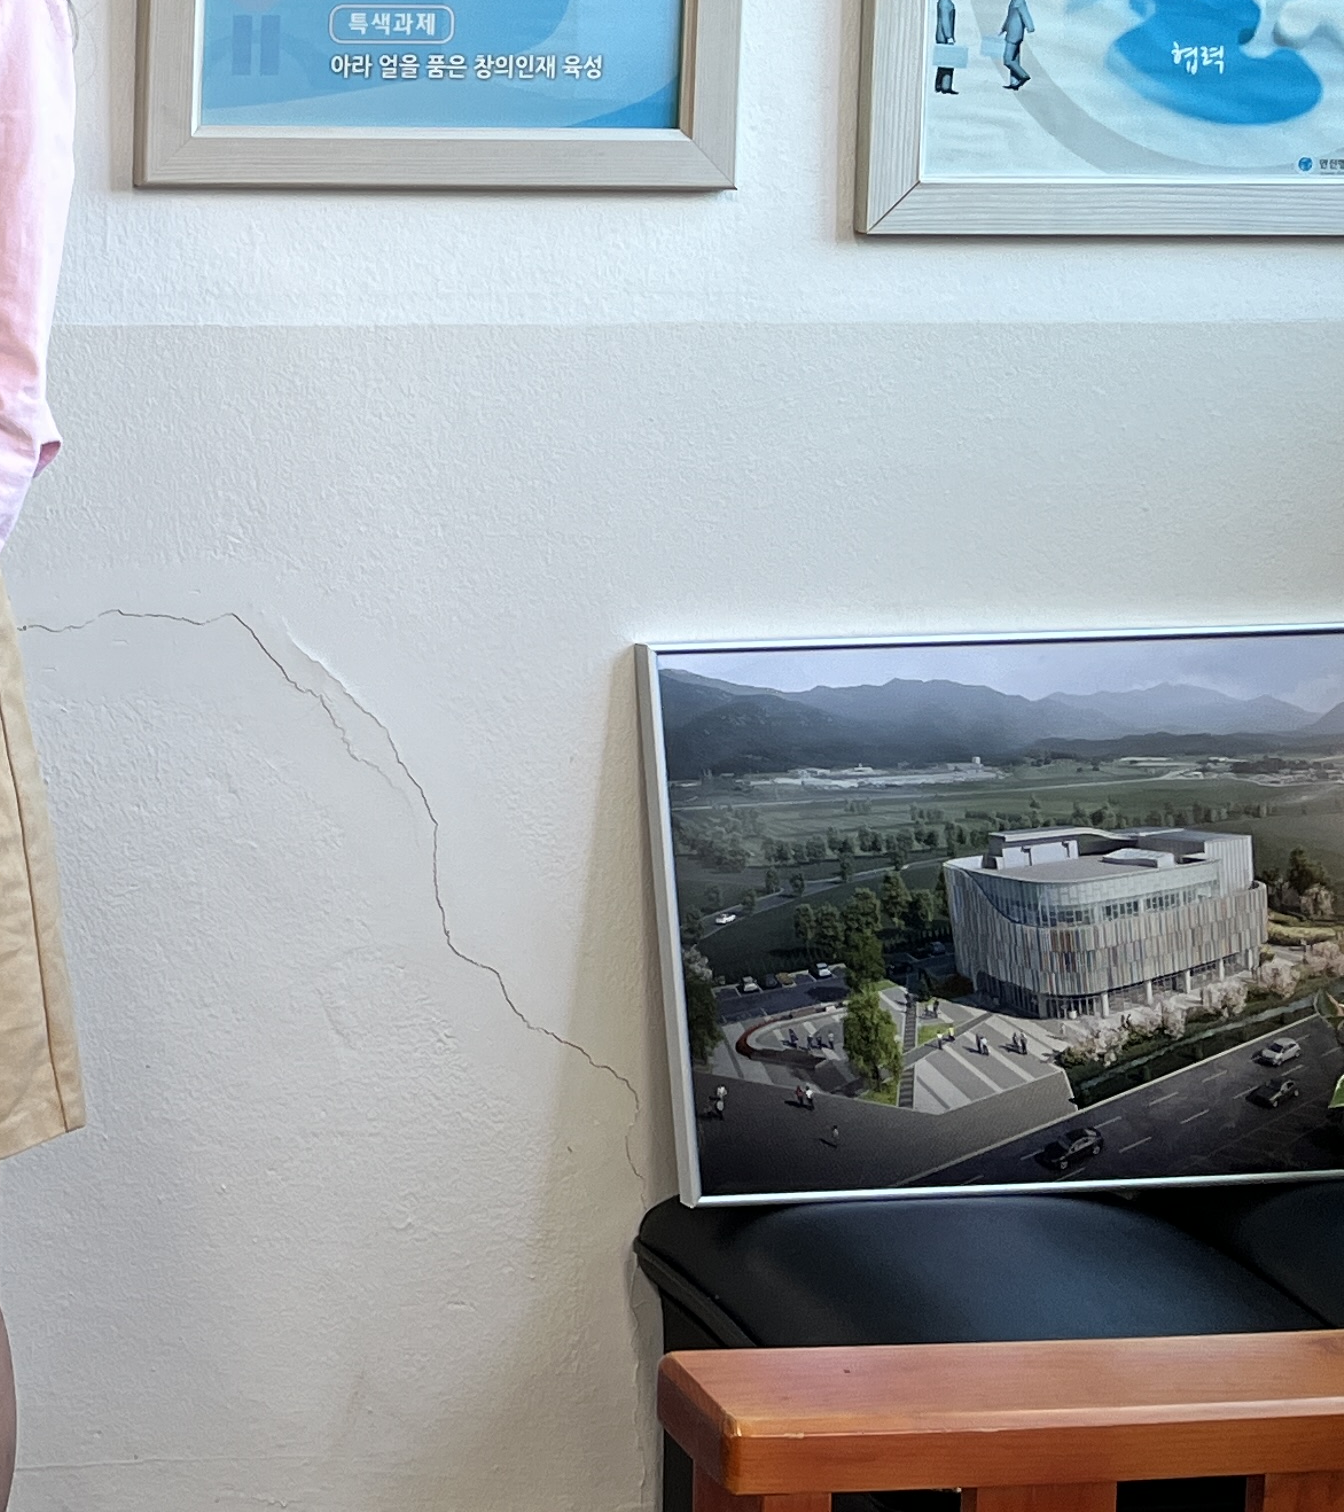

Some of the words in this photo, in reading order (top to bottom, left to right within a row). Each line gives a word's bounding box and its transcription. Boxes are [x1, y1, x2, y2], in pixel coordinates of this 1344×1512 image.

[348, 12, 436, 36] 특색과제
[330, 54, 373, 78] 아라
[379, 54, 420, 79] 얼을
[425, 54, 468, 80] 품은
[474, 54, 556, 80] 창의인재
[562, 54, 602, 80] 육성
[1171, 41, 1225, 75] 협력
